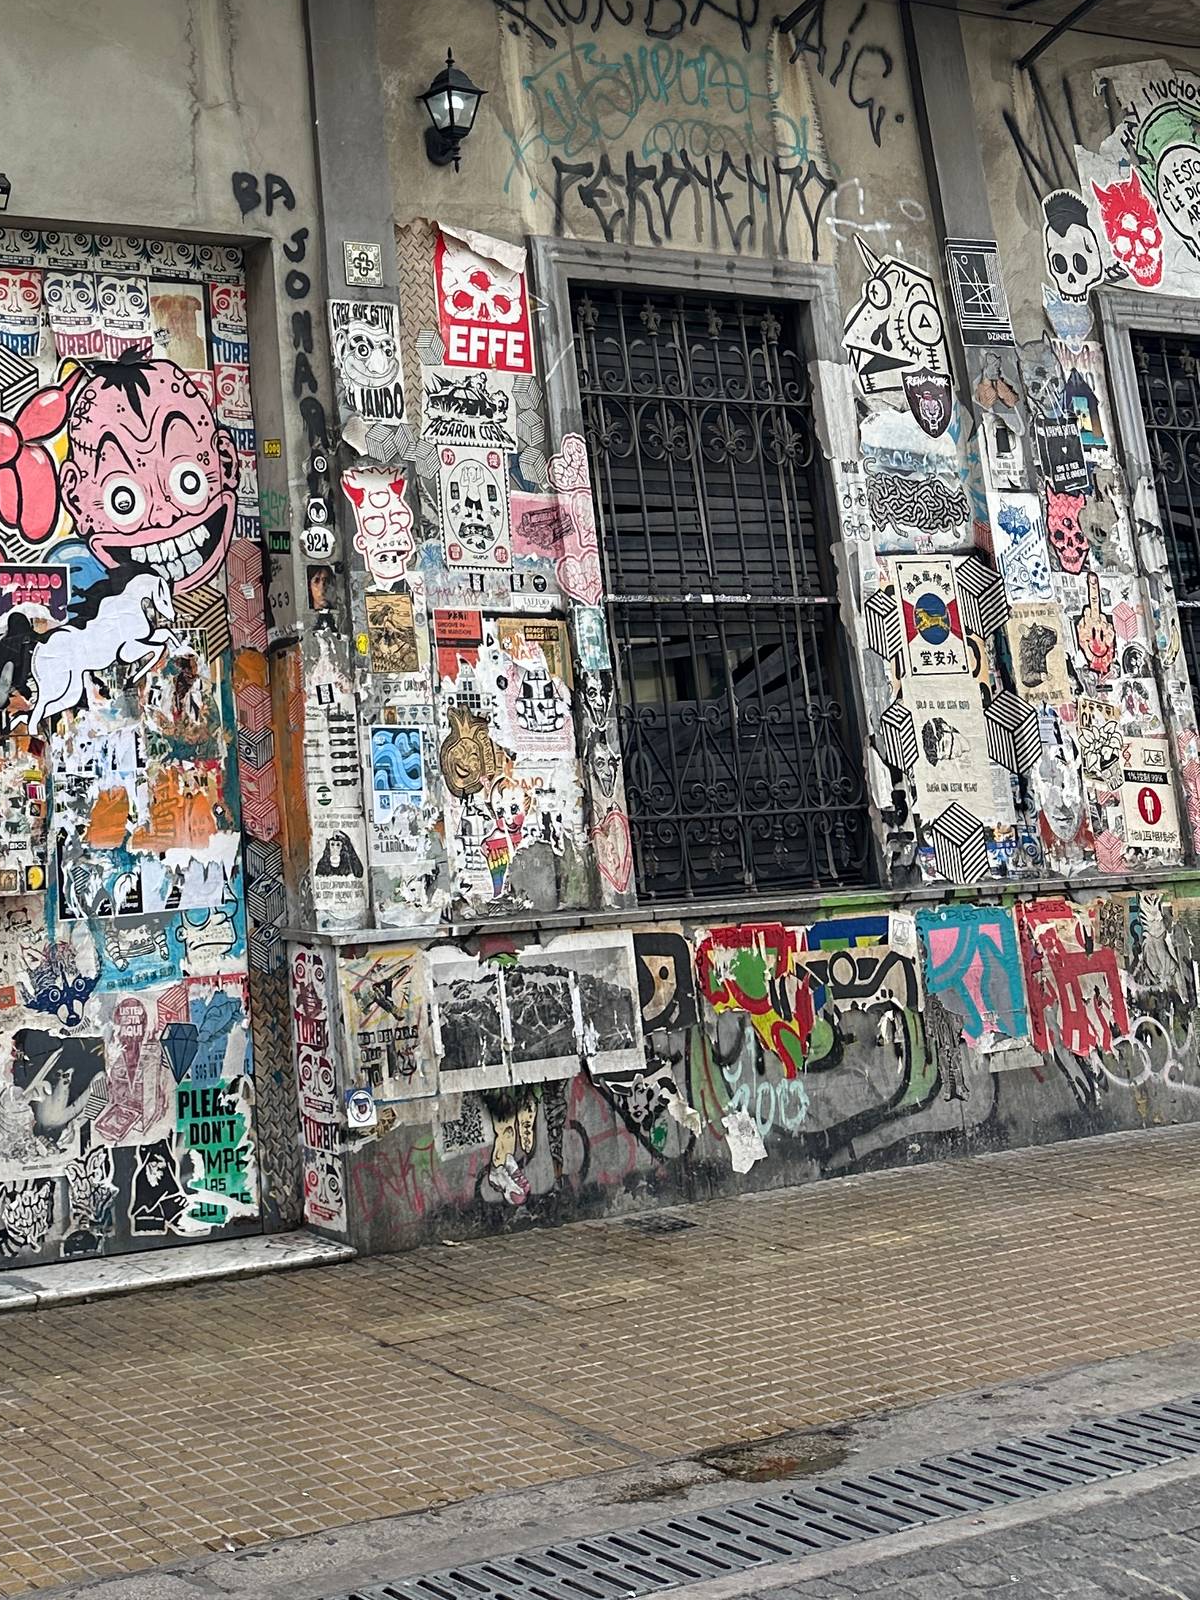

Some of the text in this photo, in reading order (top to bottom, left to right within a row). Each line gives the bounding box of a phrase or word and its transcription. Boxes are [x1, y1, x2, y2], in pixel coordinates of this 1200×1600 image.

[1143, 79, 1200, 106] MUCHO
[331, 302, 395, 338] CREO QUE ESTOY
[448, 324, 525, 368] EFFE
[422, 419, 476, 440] PASARON
[269, 535, 290, 550] lulu
[306, 532, 329, 552] 924
[11, 590, 52, 606] FEST
[178, 1087, 237, 1119] PLEAS
[189, 1119, 236, 1146] DON'T
